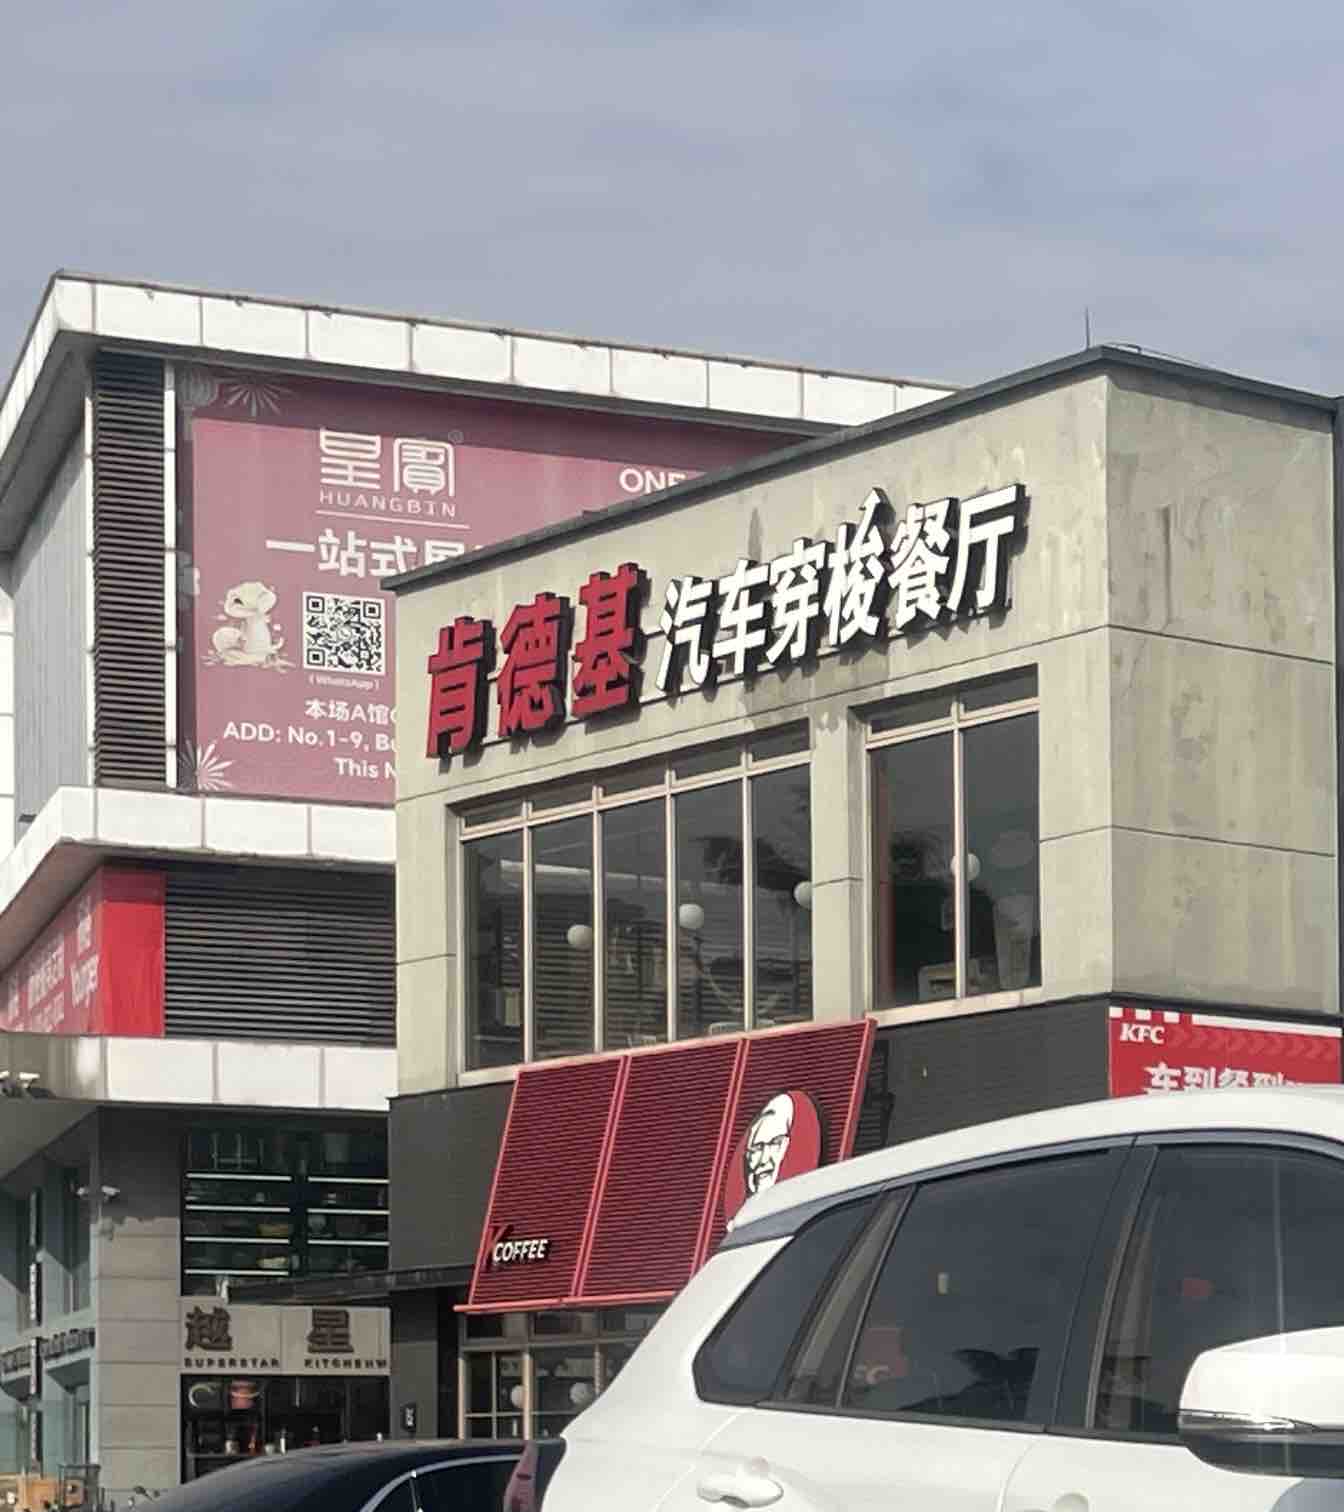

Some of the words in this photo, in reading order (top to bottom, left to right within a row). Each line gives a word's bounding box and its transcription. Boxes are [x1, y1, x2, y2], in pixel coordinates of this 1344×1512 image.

[319, 489, 457, 518] HUANGBIN
[425, 561, 641, 760] 肯德基
[655, 484, 1022, 694] 汽车穿梭餐厅
[304, 699, 397, 725] 本场A馆
[223, 721, 281, 743] ADD:
[334, 756, 379, 778] This
[1119, 1022, 1165, 1044] KFC
[492, 1238, 549, 1262] COFFEE
[184, 1356, 280, 1369] SUPERSTAR
